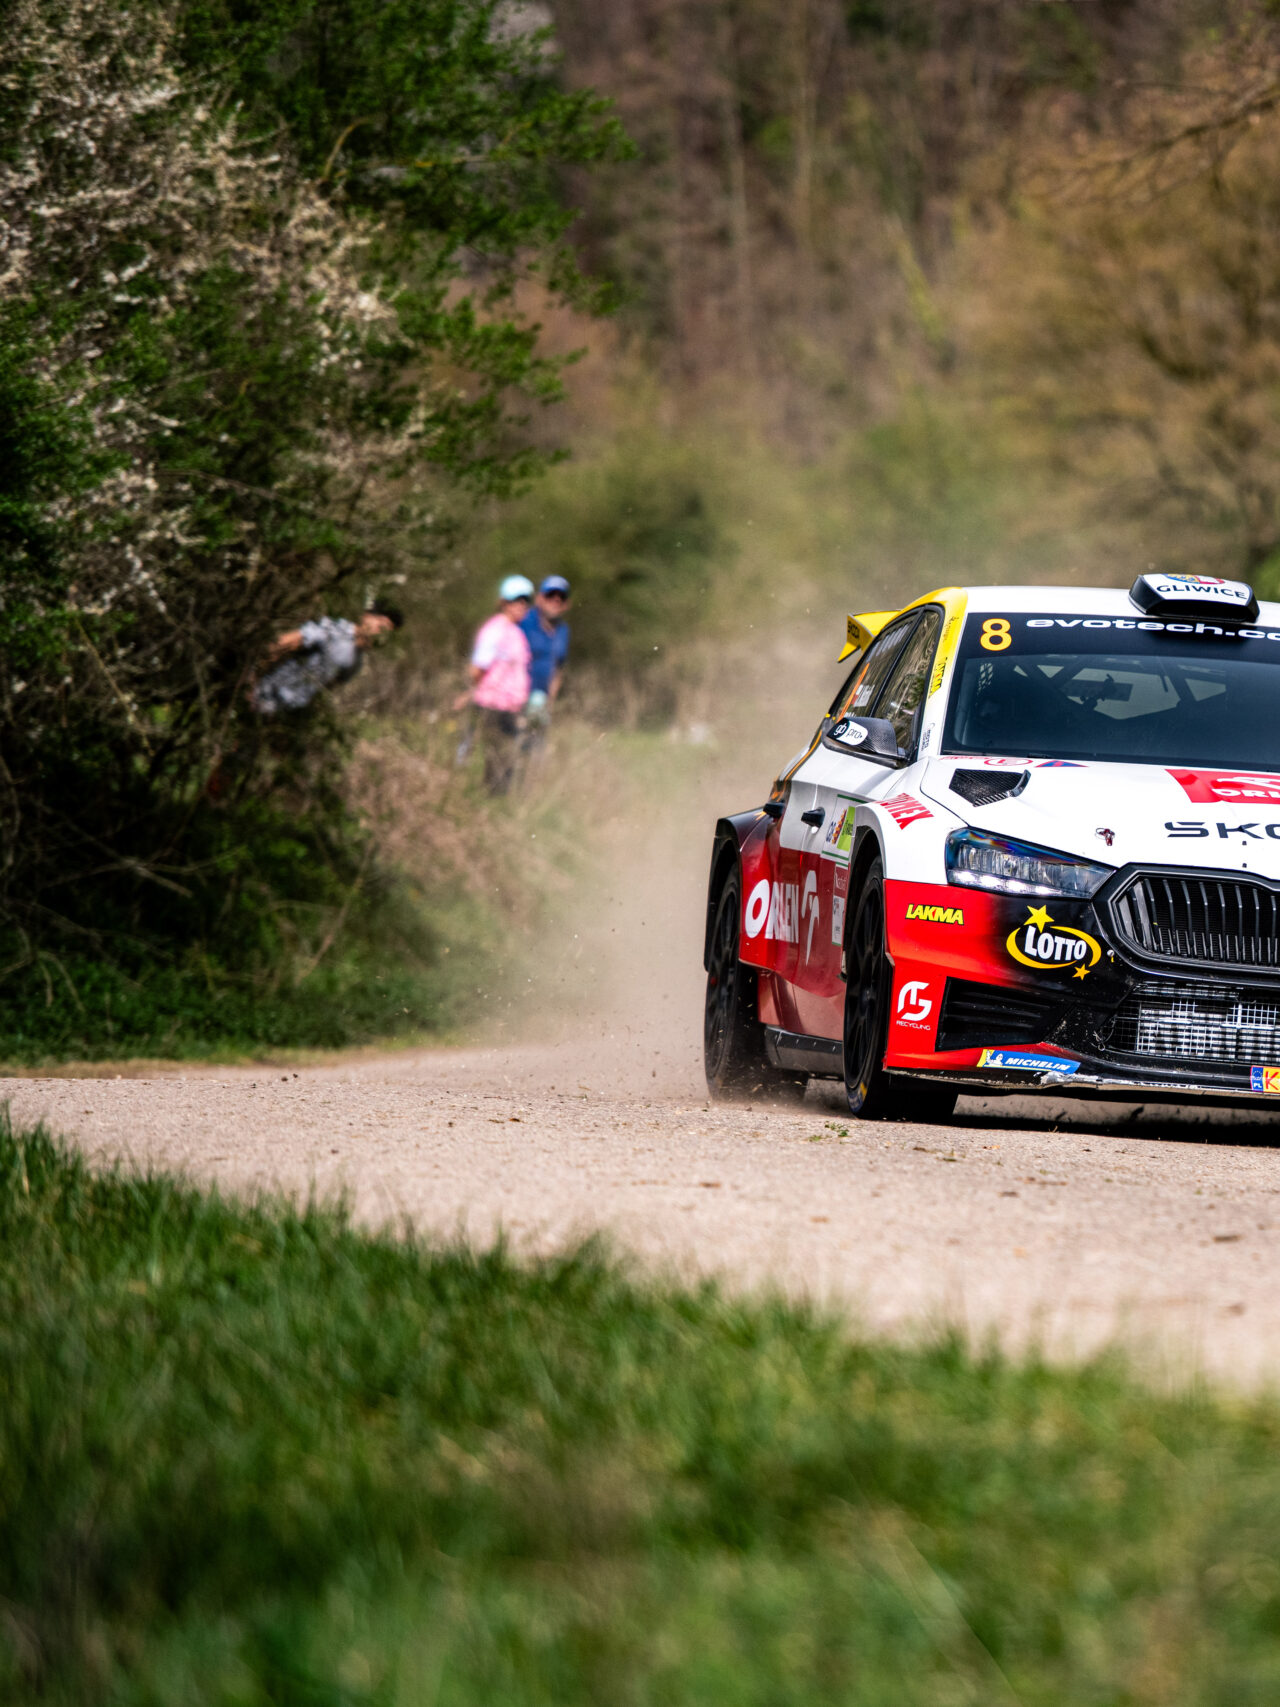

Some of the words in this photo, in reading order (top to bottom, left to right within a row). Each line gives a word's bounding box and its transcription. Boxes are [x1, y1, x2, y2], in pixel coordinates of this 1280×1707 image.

[1157, 584, 1247, 600] GLIWICE
[980, 618, 1012, 651] 8
[745, 878, 799, 944] ORLEN
[905, 904, 964, 925] LAKMA
[1024, 925, 1087, 961] LOTTO
[896, 1020, 931, 1031] RECYCLING
[1005, 1057, 1071, 1071] MICHELIN
